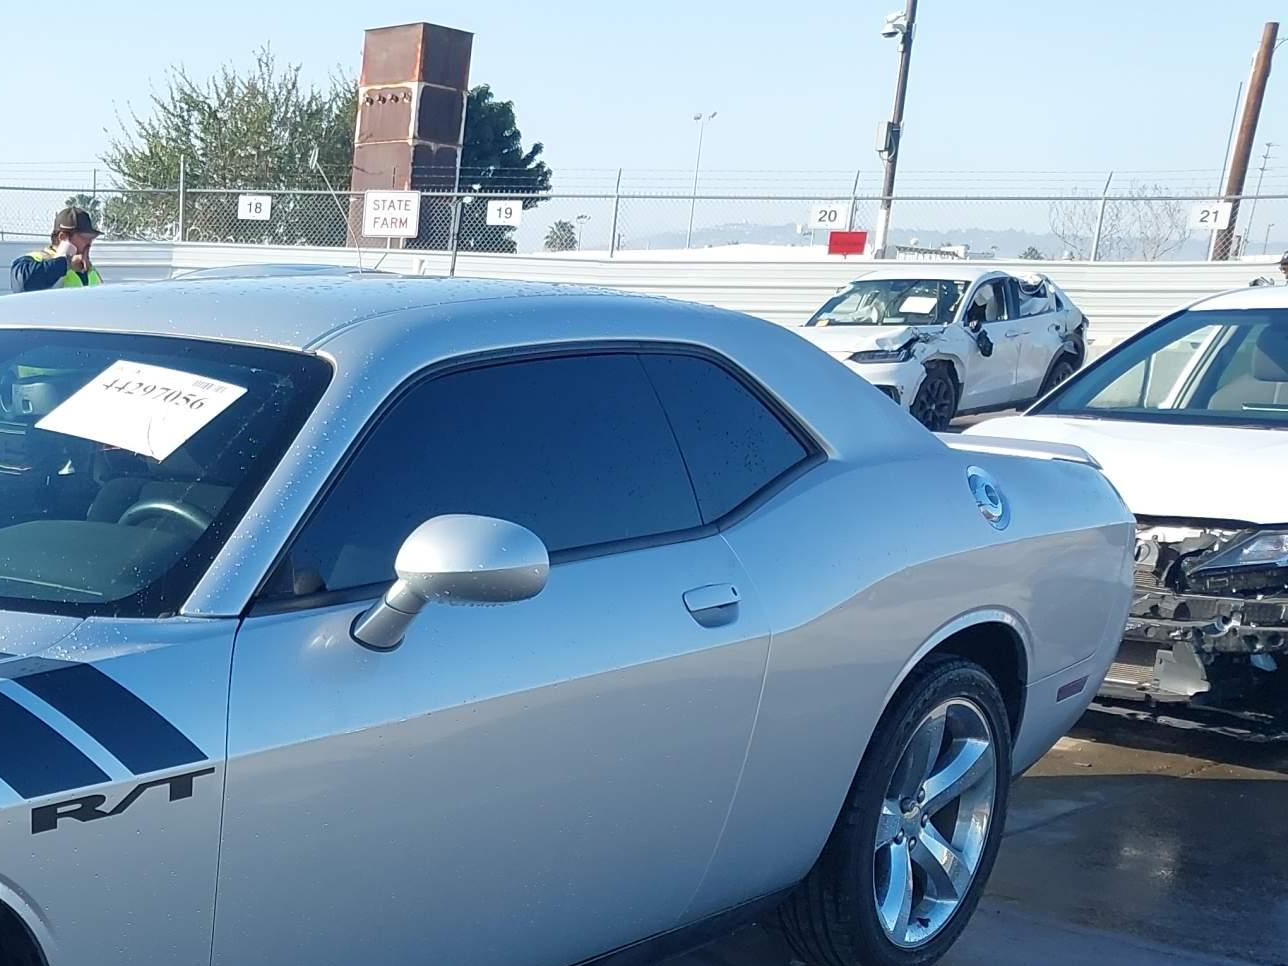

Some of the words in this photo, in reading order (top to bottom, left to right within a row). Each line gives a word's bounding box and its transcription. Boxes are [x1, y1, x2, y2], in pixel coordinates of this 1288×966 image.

[248, 202, 262, 214] 18
[373, 199, 411, 211] STATE
[497, 207, 513, 219] 19
[818, 209, 838, 222] 20
[1199, 210, 1219, 223] 21
[373, 217, 408, 229] FARM
[102, 377, 205, 410] 44297056
[31, 766, 216, 835] R/T
